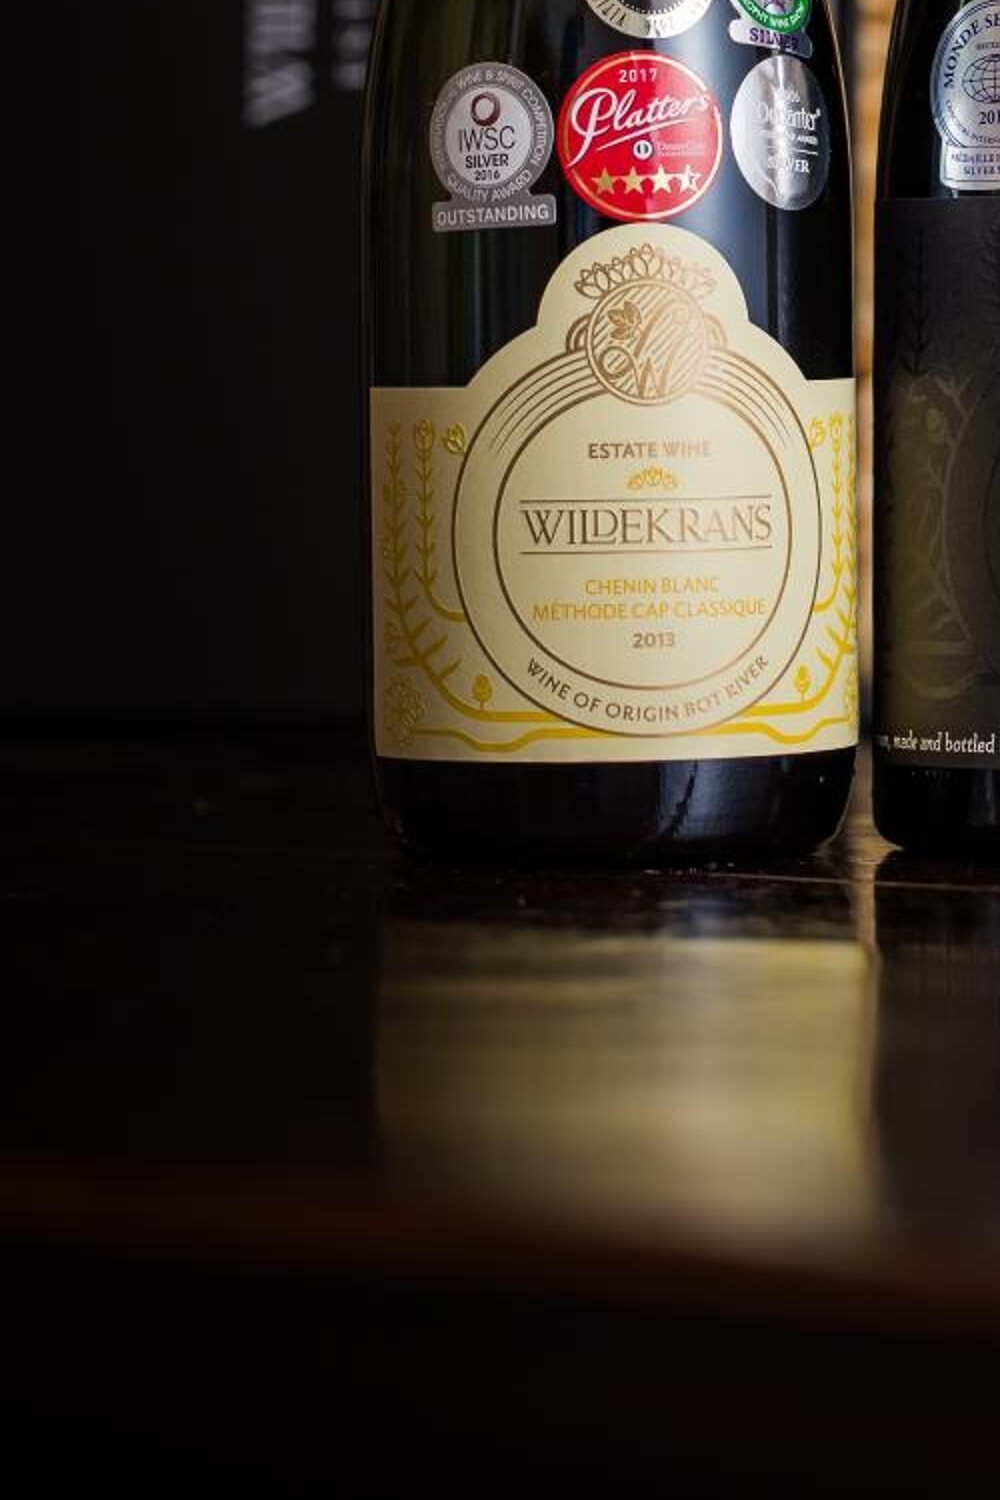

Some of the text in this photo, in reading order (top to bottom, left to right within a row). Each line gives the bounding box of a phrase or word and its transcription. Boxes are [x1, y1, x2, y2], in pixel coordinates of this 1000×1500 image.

[943, 19, 981, 89] MONDE
[618, 68, 658, 84] 2017
[457, 124, 516, 153] IWSC
[465, 152, 510, 170] SILVER
[491, 168, 533, 202] AWARD
[436, 202, 550, 227] OUTSTANDING
[588, 441, 712, 459] ESTATE WINE
[520, 504, 773, 546] WILDEKRANS
[585, 576, 720, 596] CHENIN BLANC
[631, 602, 669, 620] CAP
[673, 597, 767, 619] CLASSIQUE
[632, 632, 676, 649] 2013
[527, 655, 770, 723] WINE OF ORIGIN BOT RIVER
[920, 731, 942, 751] and
[945, 731, 996, 754] bottled
